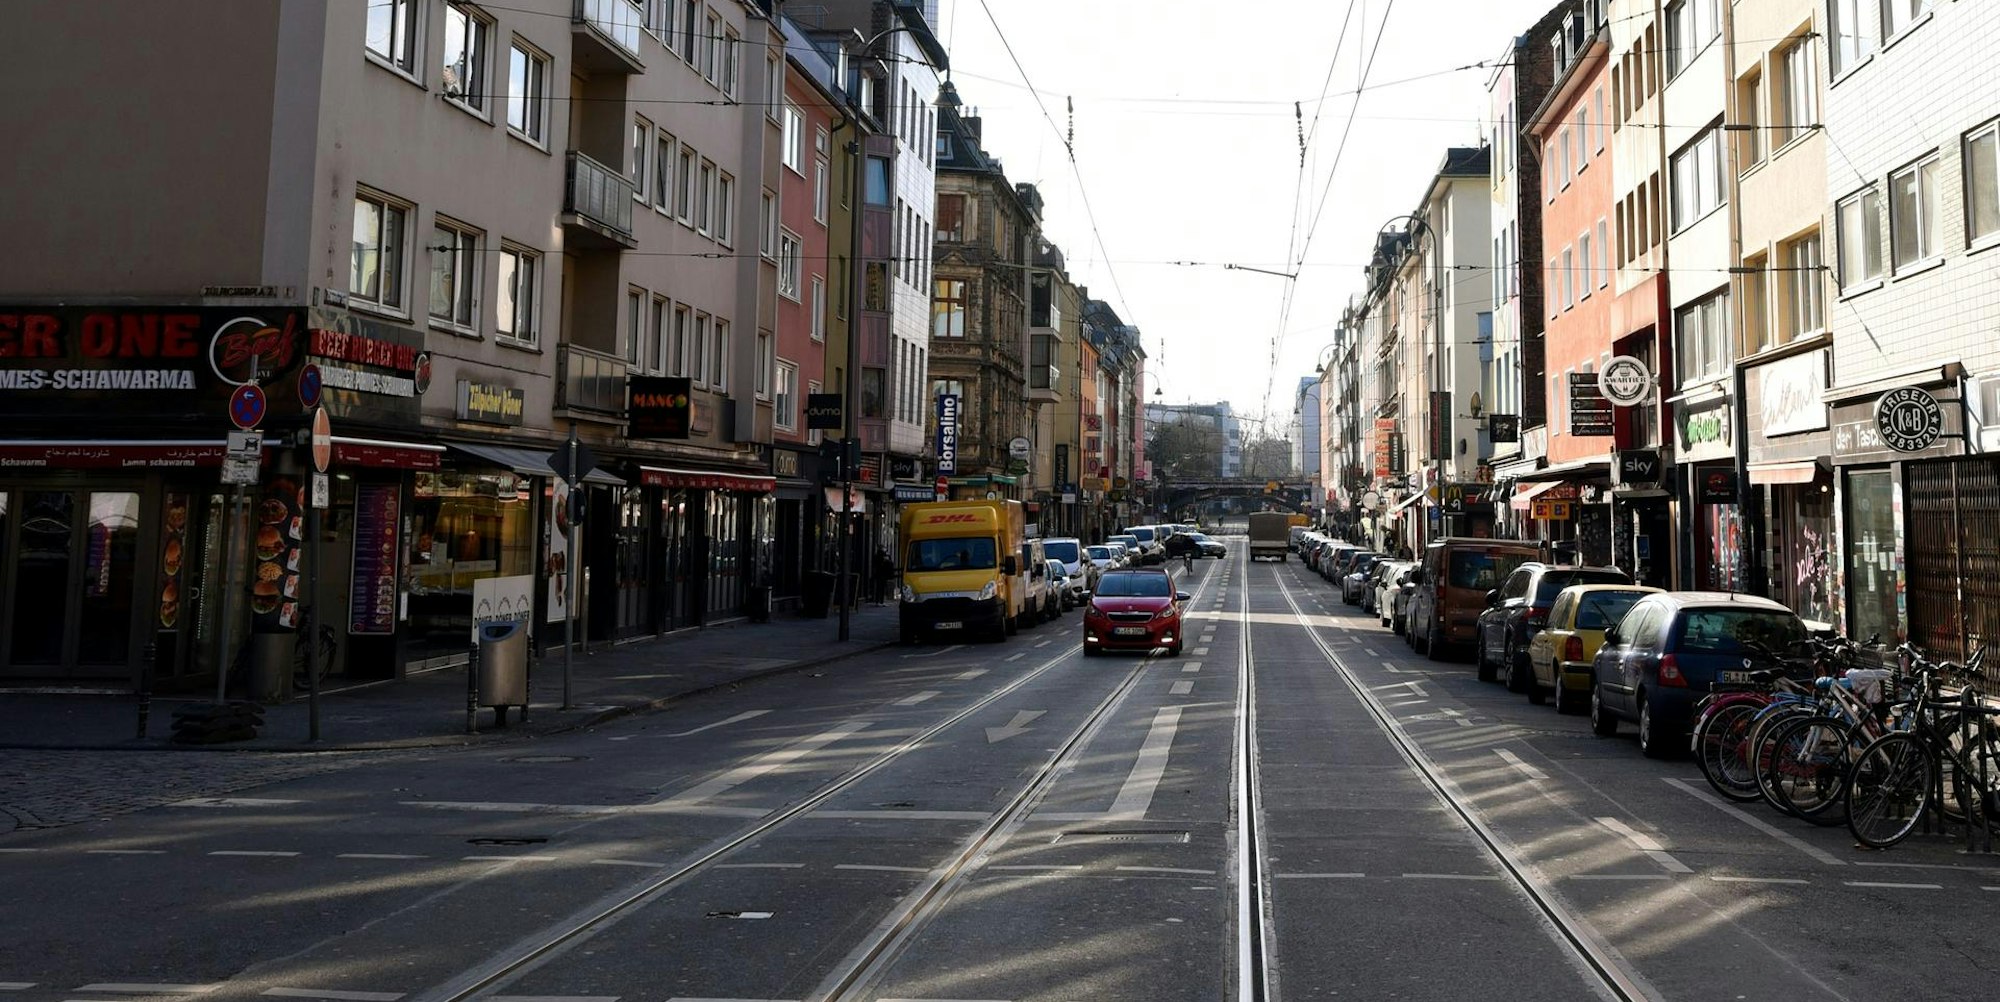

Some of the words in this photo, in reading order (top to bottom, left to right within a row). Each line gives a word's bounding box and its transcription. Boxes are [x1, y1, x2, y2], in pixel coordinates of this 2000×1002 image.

[79, 312, 200, 359] ONE
[319, 329, 350, 358] BEEF
[352, 335, 394, 367] BURGER
[397, 344, 417, 371] ONE
[0, 369, 197, 390] MES-SCHAWARMA
[469, 383, 502, 418] Zülpicher
[632, 393, 688, 408] MANGO
[1880, 389, 1938, 415] FRISEUR
[808, 406, 841, 417] duma
[1897, 407, 1922, 432] K&B
[1881, 425, 1939, 450] 9383320
[1, 457, 47, 467] Schawarma
[122, 457, 147, 467] Lamm
[149, 457, 196, 467] schawarma
[892, 461, 912, 474] sky
[1625, 458, 1652, 475] sky
[927, 514, 976, 524] DHL
[1724, 672, 1735, 682] GL
